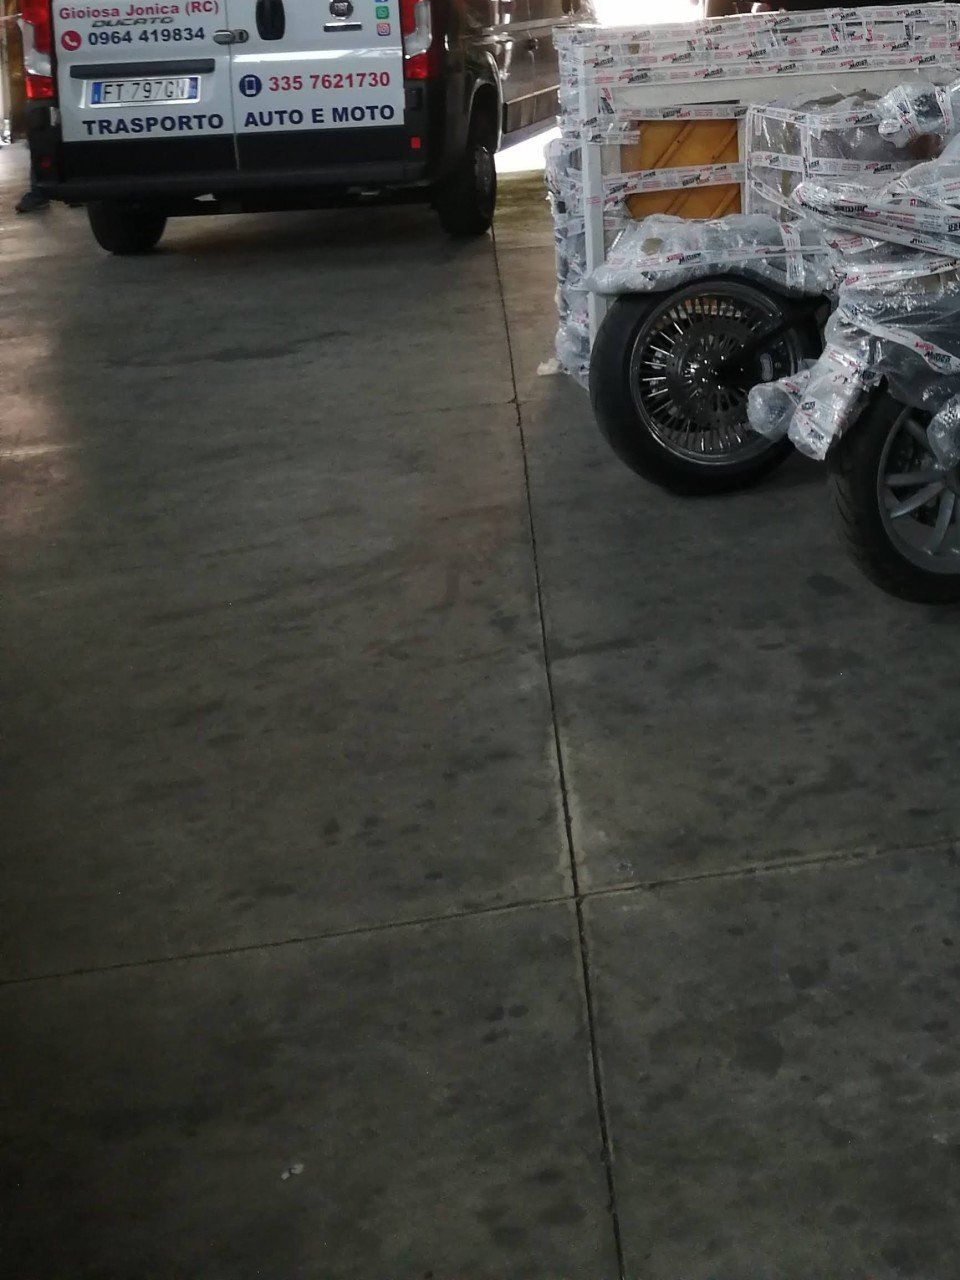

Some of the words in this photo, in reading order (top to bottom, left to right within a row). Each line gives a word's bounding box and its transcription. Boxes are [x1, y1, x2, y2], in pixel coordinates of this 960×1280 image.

[59, 4, 120, 20] Gioiosa
[125, 2, 180, 18] Jonica
[185, 0, 219, 17] (RC)
[88, 30, 133, 47] 0964
[138, 26, 205, 44] 419834
[268, 74, 303, 92] 335
[310, 71, 391, 90] 7621730
[82, 113, 224, 136] TRASPORTO
[244, 109, 304, 128] AUTO
[312, 107, 325, 124] E
[332, 104, 395, 123] MOTO
